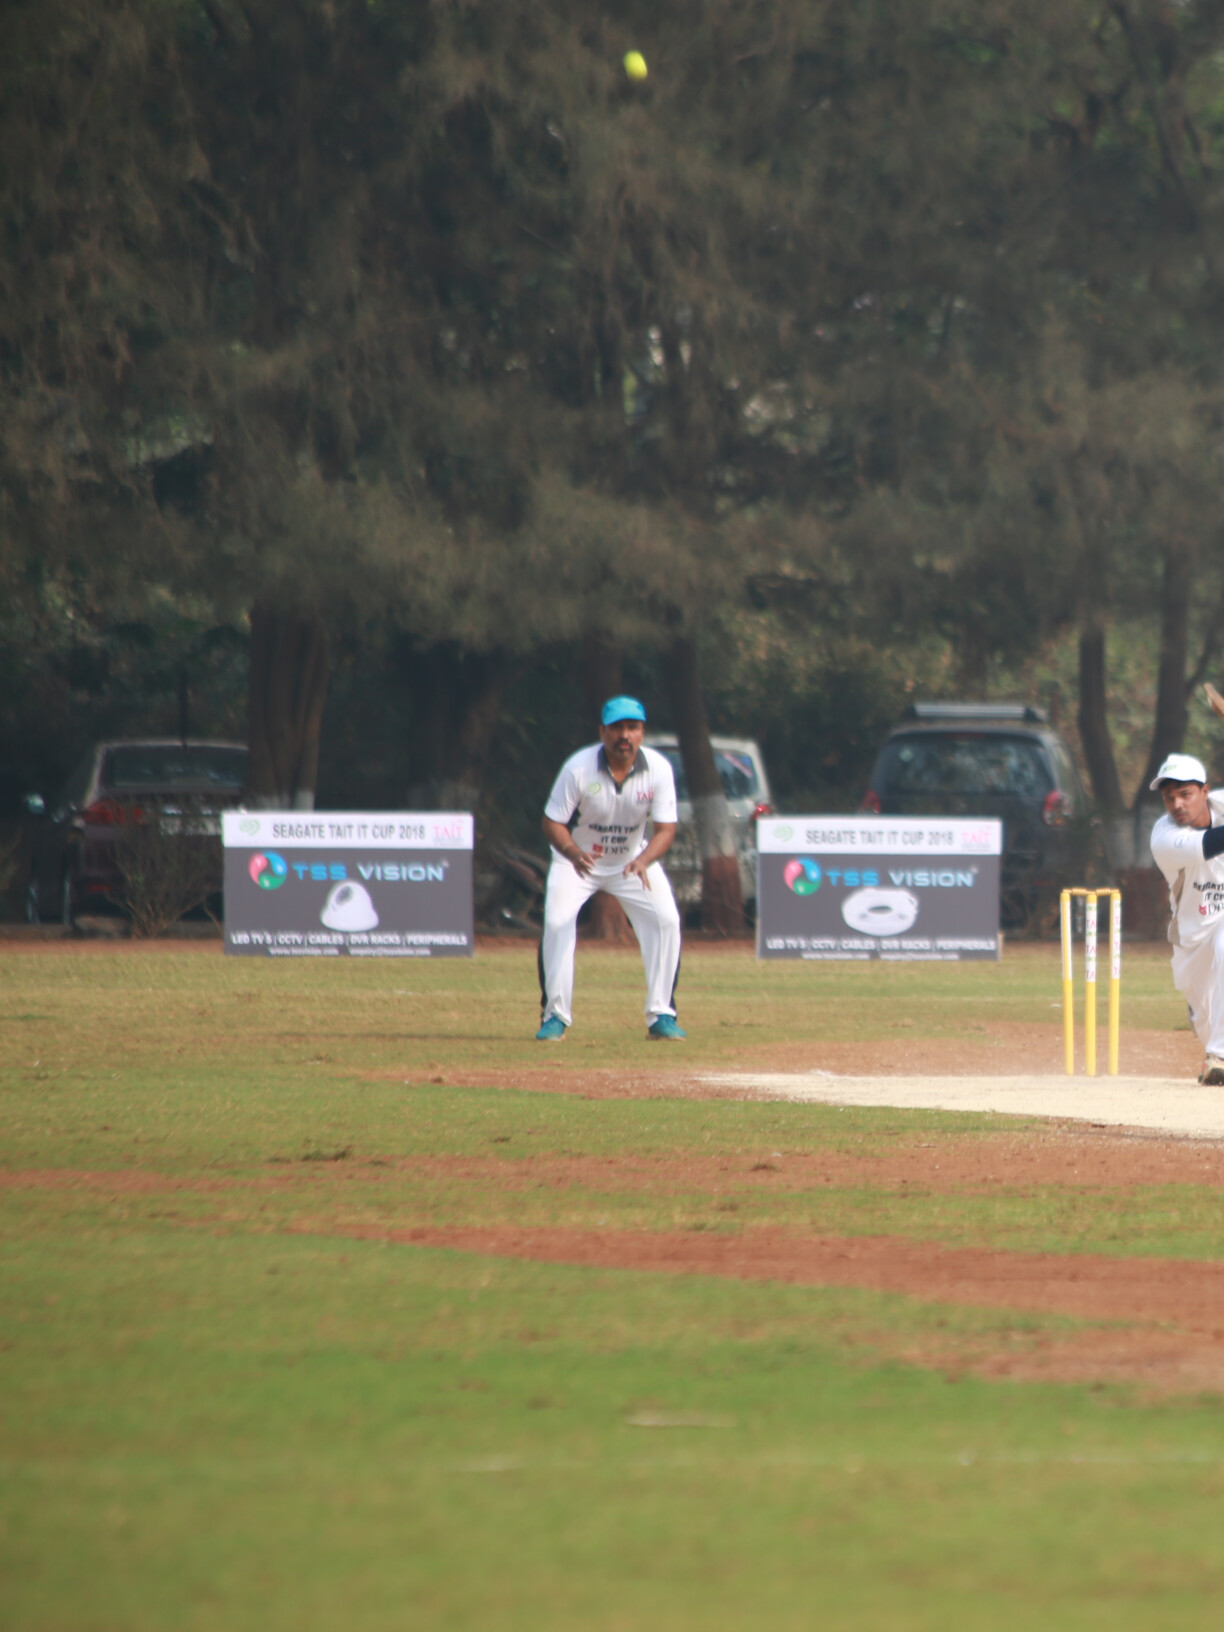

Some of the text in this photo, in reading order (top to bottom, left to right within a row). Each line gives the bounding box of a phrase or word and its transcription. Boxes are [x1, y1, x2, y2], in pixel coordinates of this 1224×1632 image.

[273, 823, 326, 839] SEAGATE
[329, 823, 354, 839] TAIT
[358, 823, 369, 839] IT
[372, 823, 396, 839] CUP
[399, 823, 426, 839] 2018
[805, 829, 856, 845] SEAGATE
[860, 829, 884, 845] TAIT
[887, 830, 899, 845] IT
[902, 830, 924, 846] CUP
[928, 830, 954, 846] 2018
[292, 861, 444, 882] TSS VISION
[826, 867, 974, 888] TSS VISION
[231, 932, 250, 945] LED
[278, 932, 303, 945] CCTV
[308, 932, 344, 945] CABLES
[350, 934, 369, 946] DVR
[371, 934, 401, 946] RACKS
[406, 933, 468, 946] PERIPHERALS
